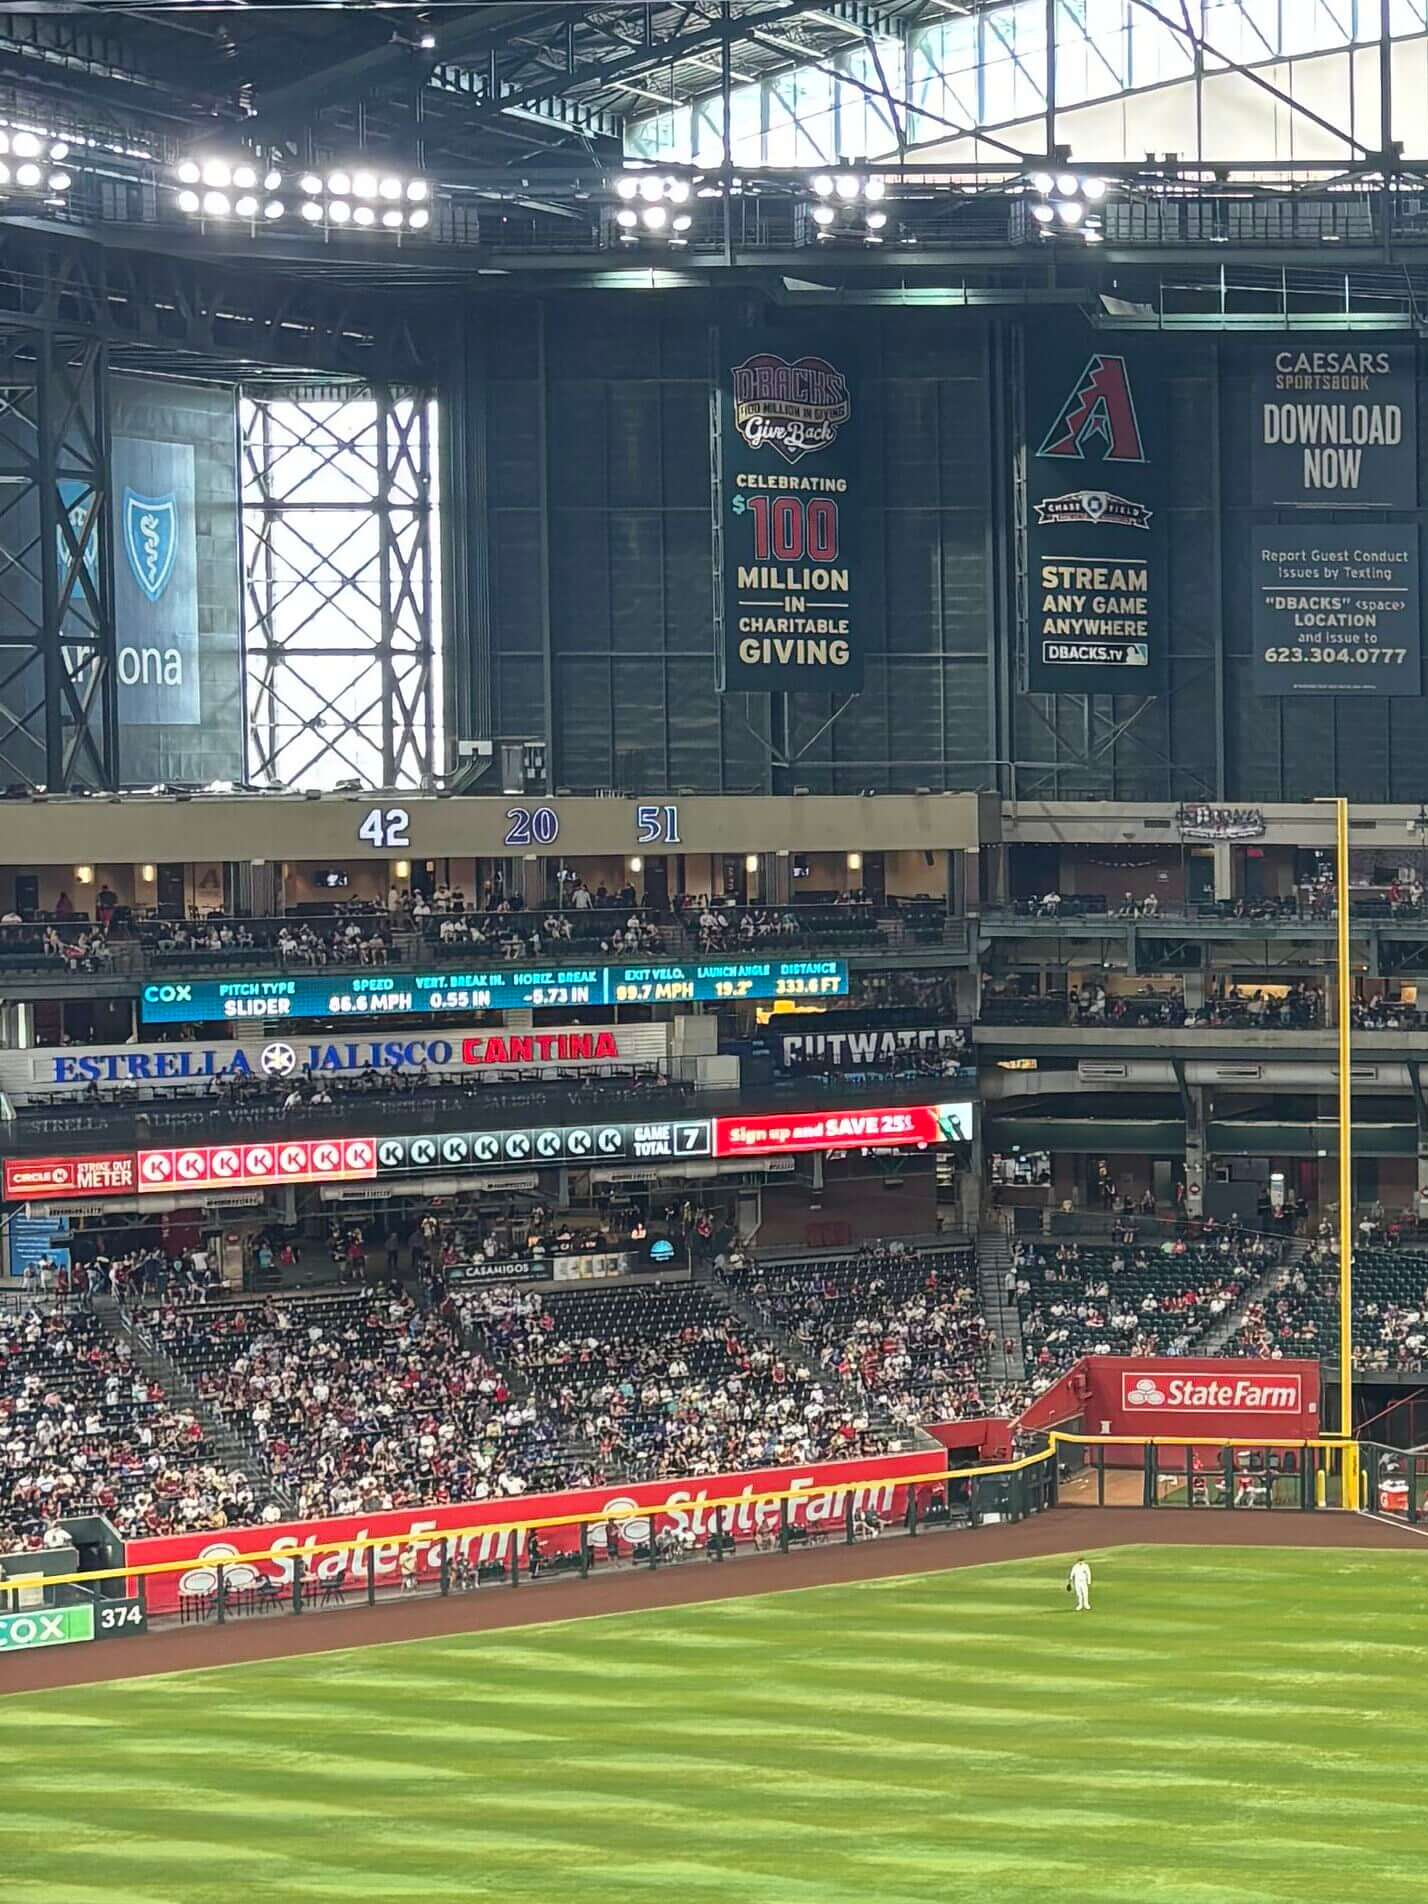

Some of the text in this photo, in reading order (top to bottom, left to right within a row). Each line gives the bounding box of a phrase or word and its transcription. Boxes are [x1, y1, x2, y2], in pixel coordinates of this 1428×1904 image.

[1275, 352, 1390, 374] CAESARS
[1276, 375, 1369, 390] SPORTSBOOK
[745, 416, 833, 449] Give Back
[1264, 403, 1401, 445] DOWNLOAD
[1304, 448, 1362, 489] NOW
[736, 474, 847, 493] CELEBRATING
[732, 494, 839, 563] $100
[1262, 549, 1409, 563] Report Guest Conduct
[736, 566, 849, 591] MILLION
[1041, 566, 1148, 591] STREAM
[1323, 567, 1339, 580] by
[1344, 567, 1392, 581] Texting
[784, 596, 806, 613] IN
[1042, 595, 1148, 615] ANY GAME
[738, 617, 849, 634] CHARITABLE
[1043, 618, 1148, 636] ANYWHERE
[1295, 613, 1377, 627] LOCATION
[1298, 631, 1322, 643] and
[1364, 632, 1378, 644] to
[739, 638, 850, 665] GIVING
[1264, 647, 1407, 664] 623.304.0777
[359, 808, 410, 847] 42
[504, 807, 559, 846] 20
[637, 805, 681, 844] 51
[557, 970, 597, 984] BREAK
[779, 961, 837, 976] DISTANCE
[219, 981, 296, 997] PITCH TYPE
[352, 978, 394, 992] SPEED
[449, 974, 487, 988] BREAK
[654, 981, 695, 1000] MPH
[820, 976, 842, 993] FT
[143, 984, 192, 1003] COX
[370, 992, 412, 1011] MPH
[429, 989, 491, 1009] 0.55 IN
[571, 985, 589, 1003] IN
[223, 998, 291, 1017] SLIDER
[52, 1032, 618, 1084] ESTRELLA JALISCO CANTINA
[634, 1125, 670, 1142] GAME
[683, 1128, 700, 1149] 7
[729, 1117, 880, 1144] Sign up and SAVE
[634, 1141, 672, 1157] TOTAL
[113, 1159, 132, 1172] OUT
[76, 1171, 132, 1189] METER
[100, 1605, 143, 1630] 374
